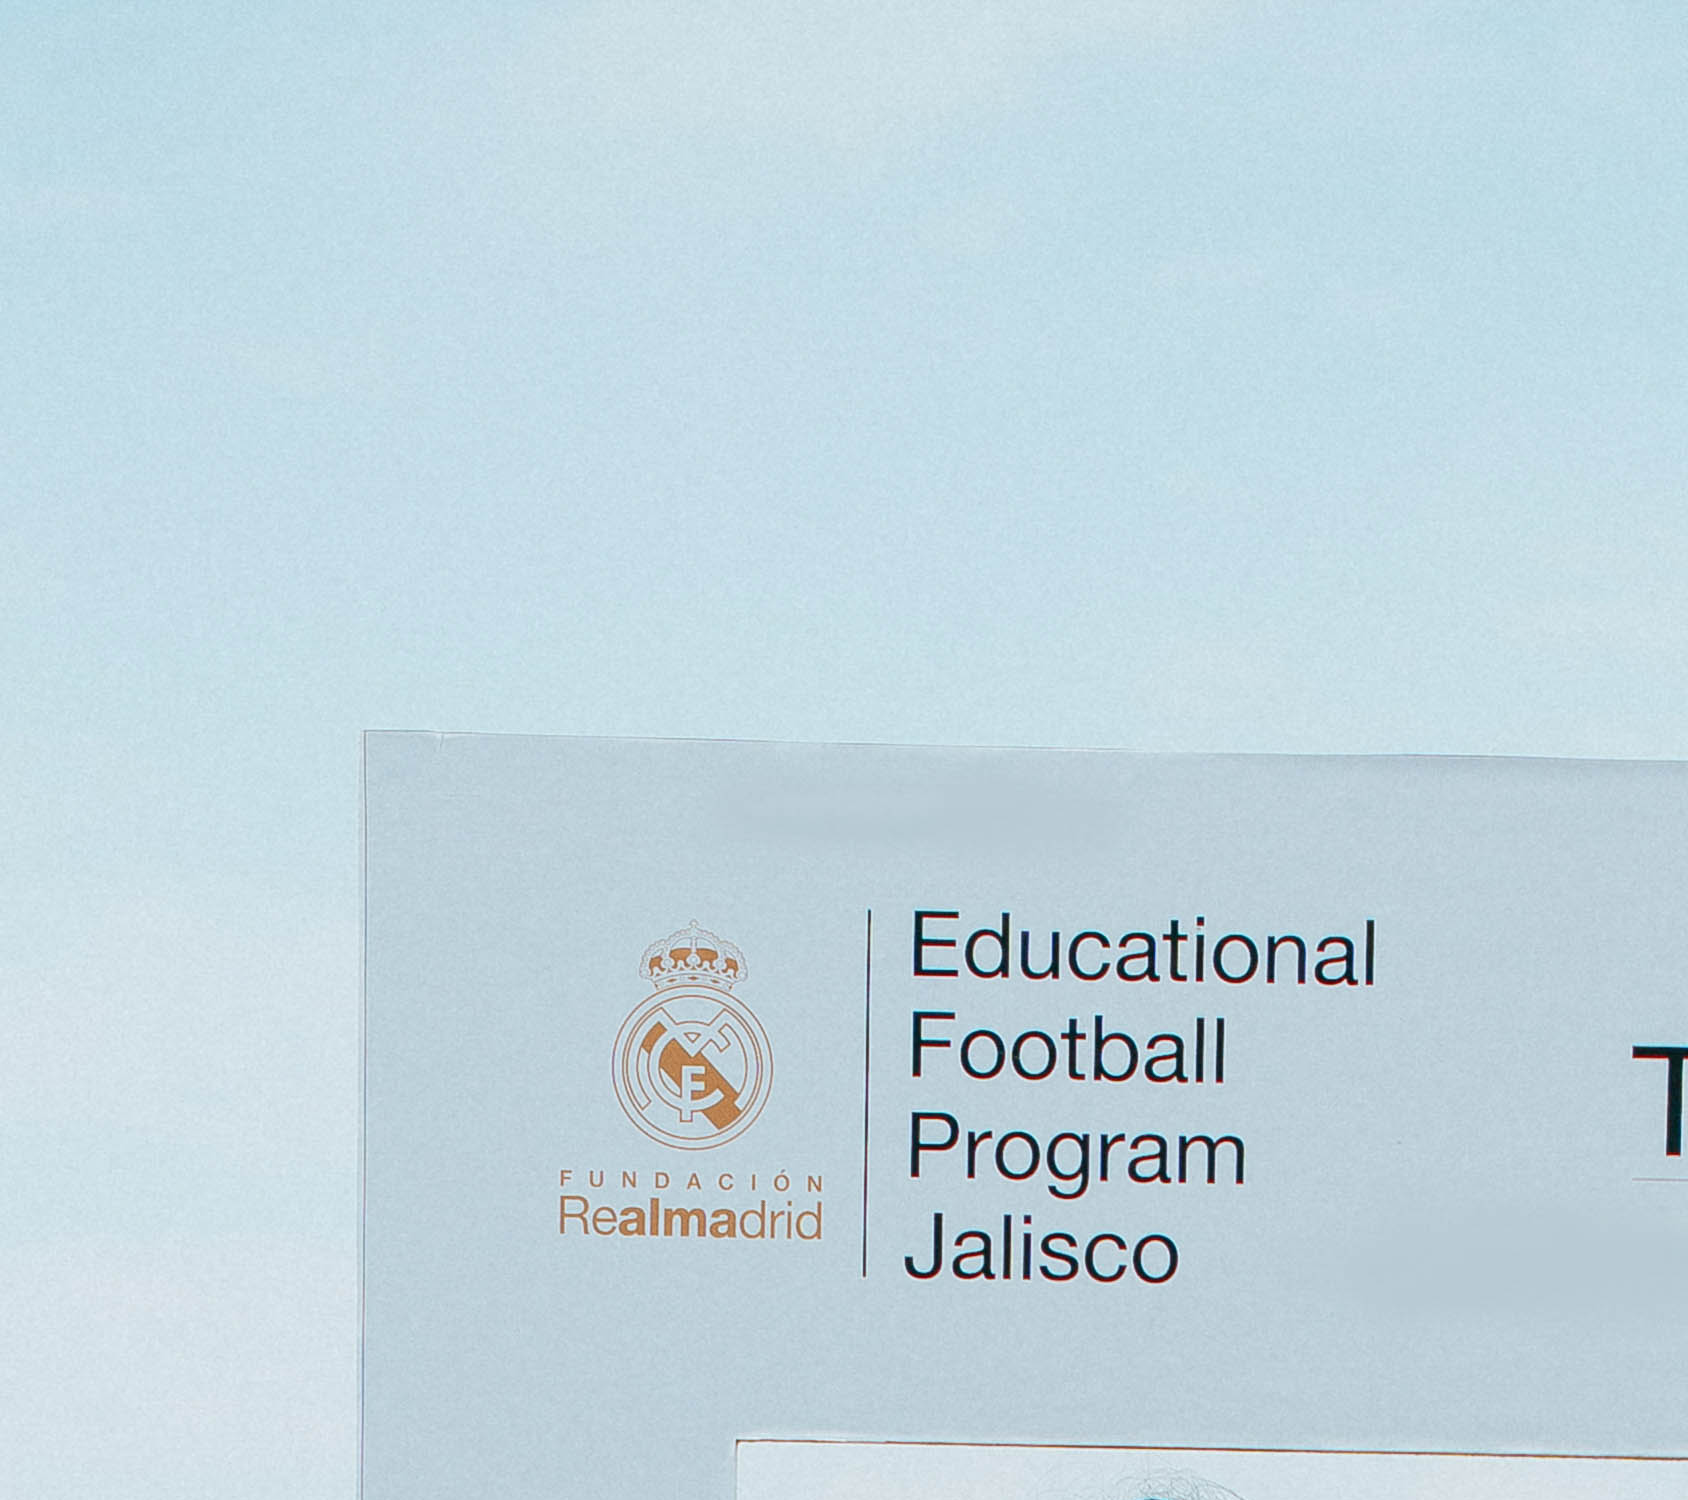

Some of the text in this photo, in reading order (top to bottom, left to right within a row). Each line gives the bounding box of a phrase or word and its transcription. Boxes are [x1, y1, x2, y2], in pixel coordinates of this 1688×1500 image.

[915, 911, 1375, 986] Educational
[914, 1011, 1226, 1084] Football
[561, 1170, 823, 1193] FUNDACIÓN
[912, 1112, 1246, 1200] Program
[560, 1196, 823, 1241] Realmadrid
[905, 1213, 1180, 1284] Jalisco
